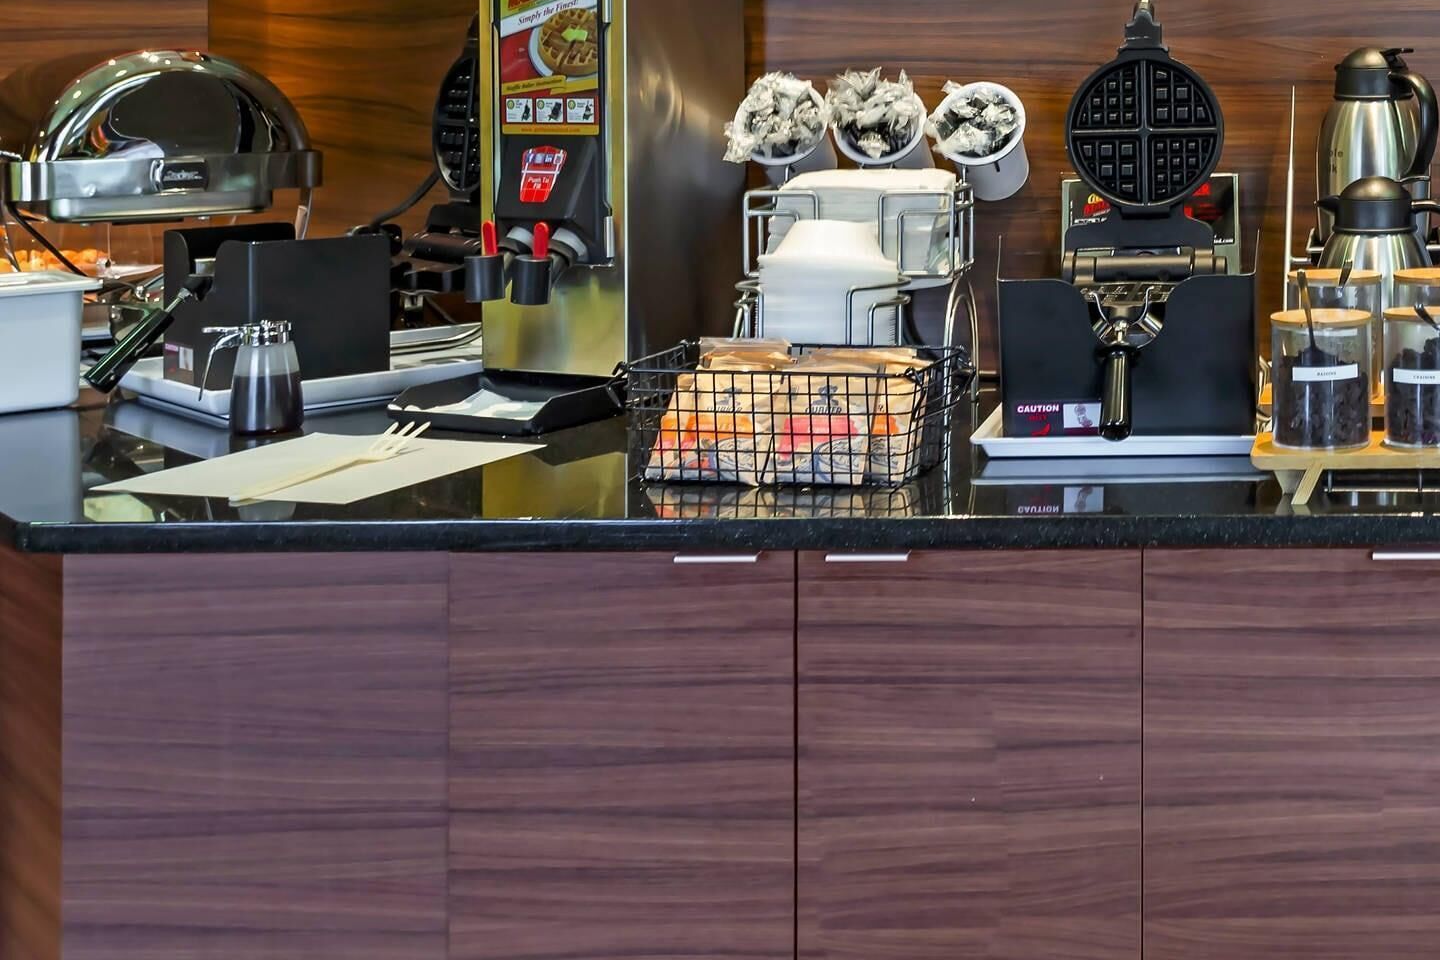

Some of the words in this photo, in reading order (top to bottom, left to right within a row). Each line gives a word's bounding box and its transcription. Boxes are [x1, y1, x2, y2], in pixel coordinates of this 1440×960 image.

[518, 10, 542, 26] Simply
[543, 5, 556, 16] the
[1017, 404, 1060, 414] CAUTION
